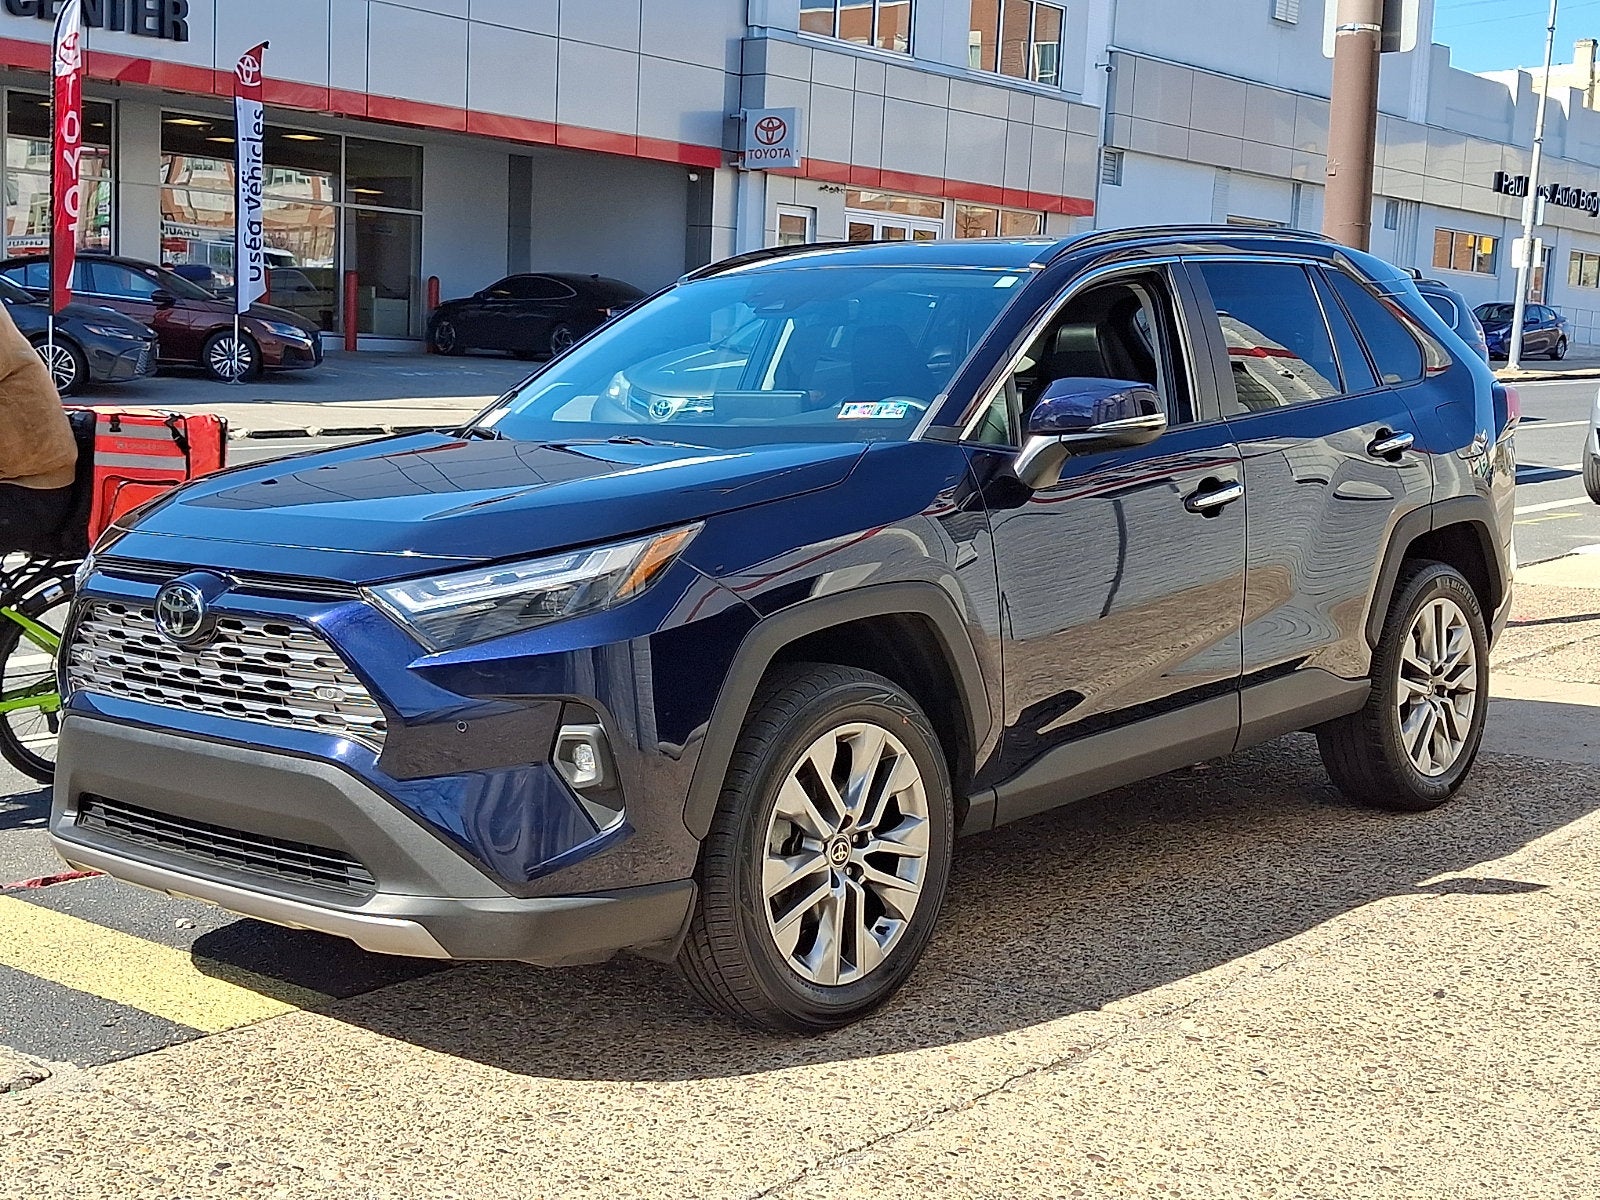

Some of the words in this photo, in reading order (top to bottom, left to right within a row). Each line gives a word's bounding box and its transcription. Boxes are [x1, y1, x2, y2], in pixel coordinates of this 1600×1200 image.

[748, 148, 791, 160] TOYOTA
[62, 72, 81, 289] TOYO
[1500, 172, 1526, 197] Paul
[1554, 184, 1577, 207] Auto
